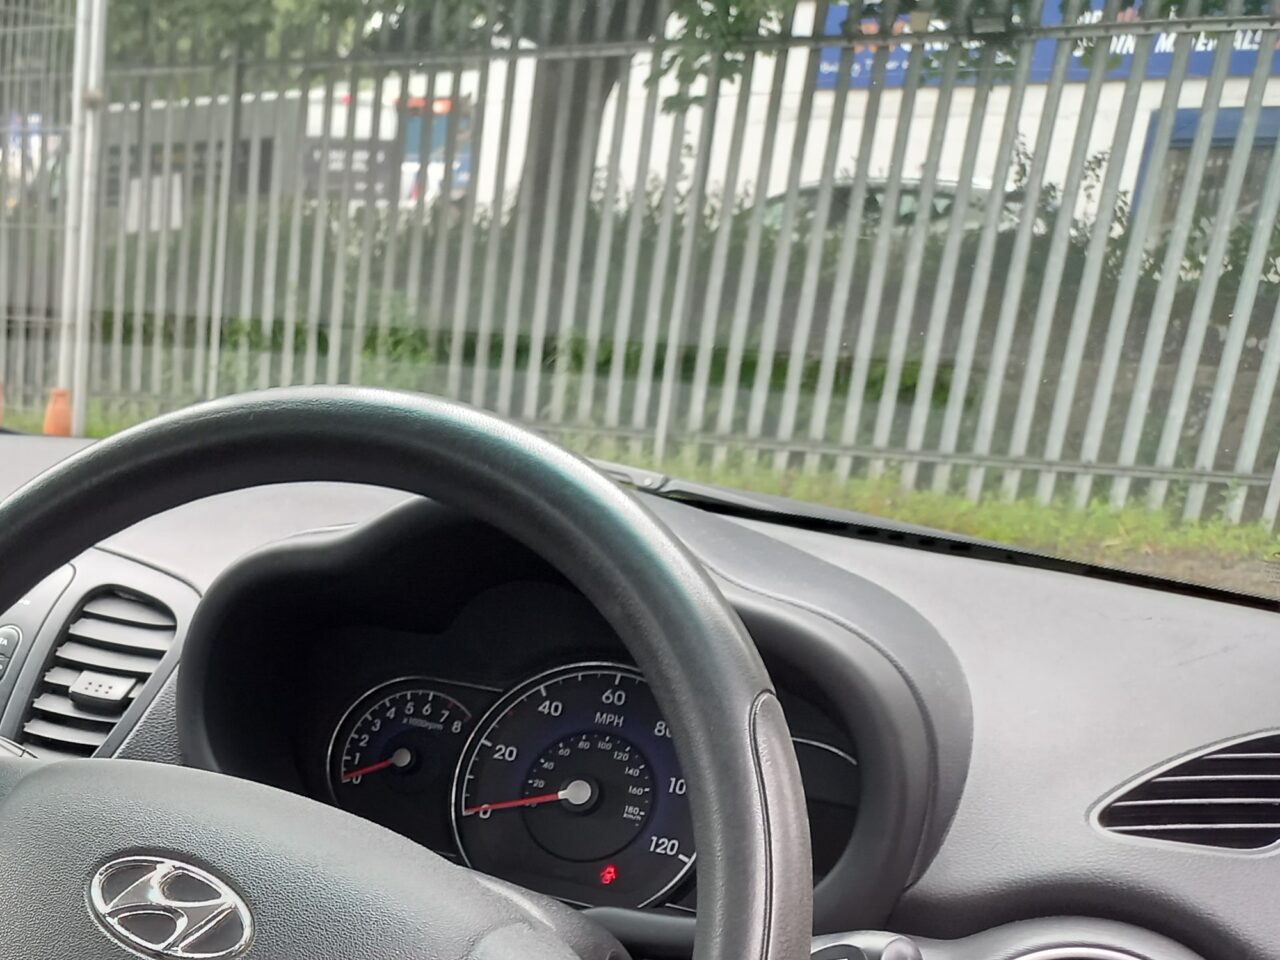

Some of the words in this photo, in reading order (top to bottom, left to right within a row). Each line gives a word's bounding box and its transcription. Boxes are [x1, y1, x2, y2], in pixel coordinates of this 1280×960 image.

[602, 689, 625, 705] 60
[386, 707, 396, 719] 4
[405, 702, 414, 714] 5
[422, 703, 431, 716] 6
[538, 701, 562, 716] 40
[440, 710, 449, 722] 7
[594, 711, 624, 727] MPH
[371, 719, 381, 732] 3
[452, 721, 461, 733] 8
[360, 734, 369, 747] 2
[578, 740, 590, 750] 80
[597, 740, 612, 750] 100
[493, 745, 517, 761] 20
[558, 747, 570, 757] 60
[613, 751, 629, 762] 120
[354, 752, 360, 765] 1
[543, 761, 554, 770] 40
[624, 766, 640, 776] 140
[533, 779, 544, 788] 20
[669, 777, 686, 794] 10
[628, 785, 643, 795] 160
[624, 806, 639, 815] 180
[649, 836, 678, 855] 120
